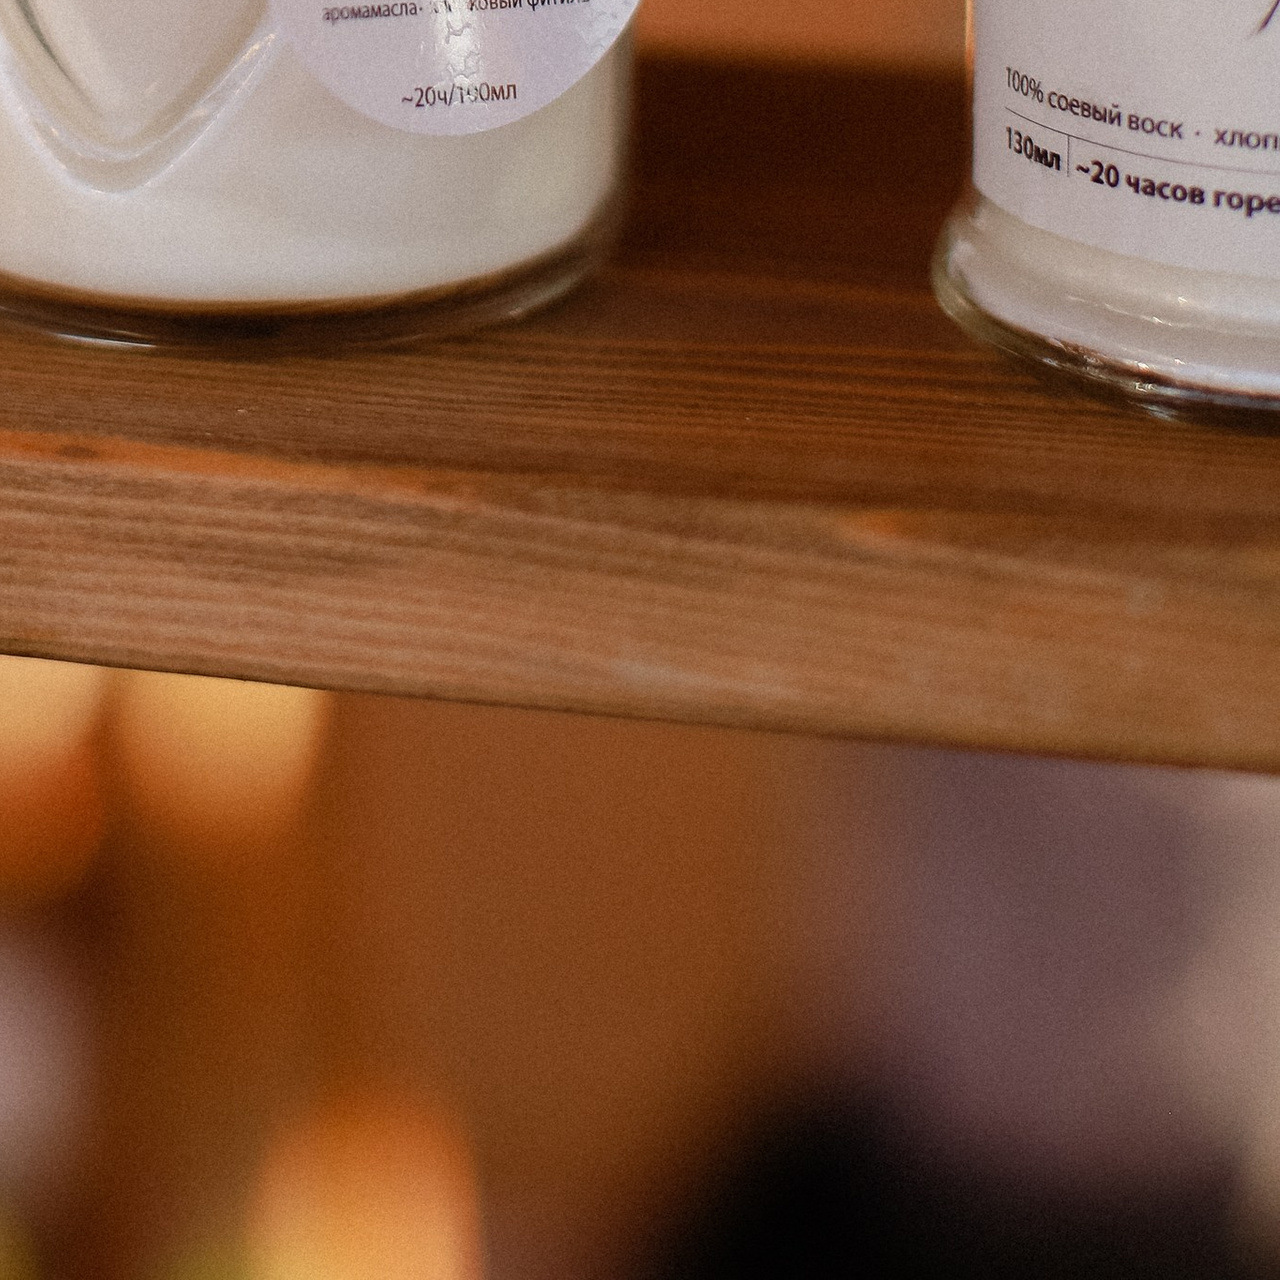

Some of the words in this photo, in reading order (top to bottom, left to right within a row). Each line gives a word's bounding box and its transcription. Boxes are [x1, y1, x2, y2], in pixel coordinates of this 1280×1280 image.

[322, 0, 419, 25] аромамасла
[1005, 66, 1044, 103] 100%
[1047, 91, 1122, 128] соевый
[1128, 113, 1184, 140] воск
[1005, 126, 1062, 172] 130мл
[1125, 174, 1206, 206] часов
[1213, 189, 1280, 218] горе
